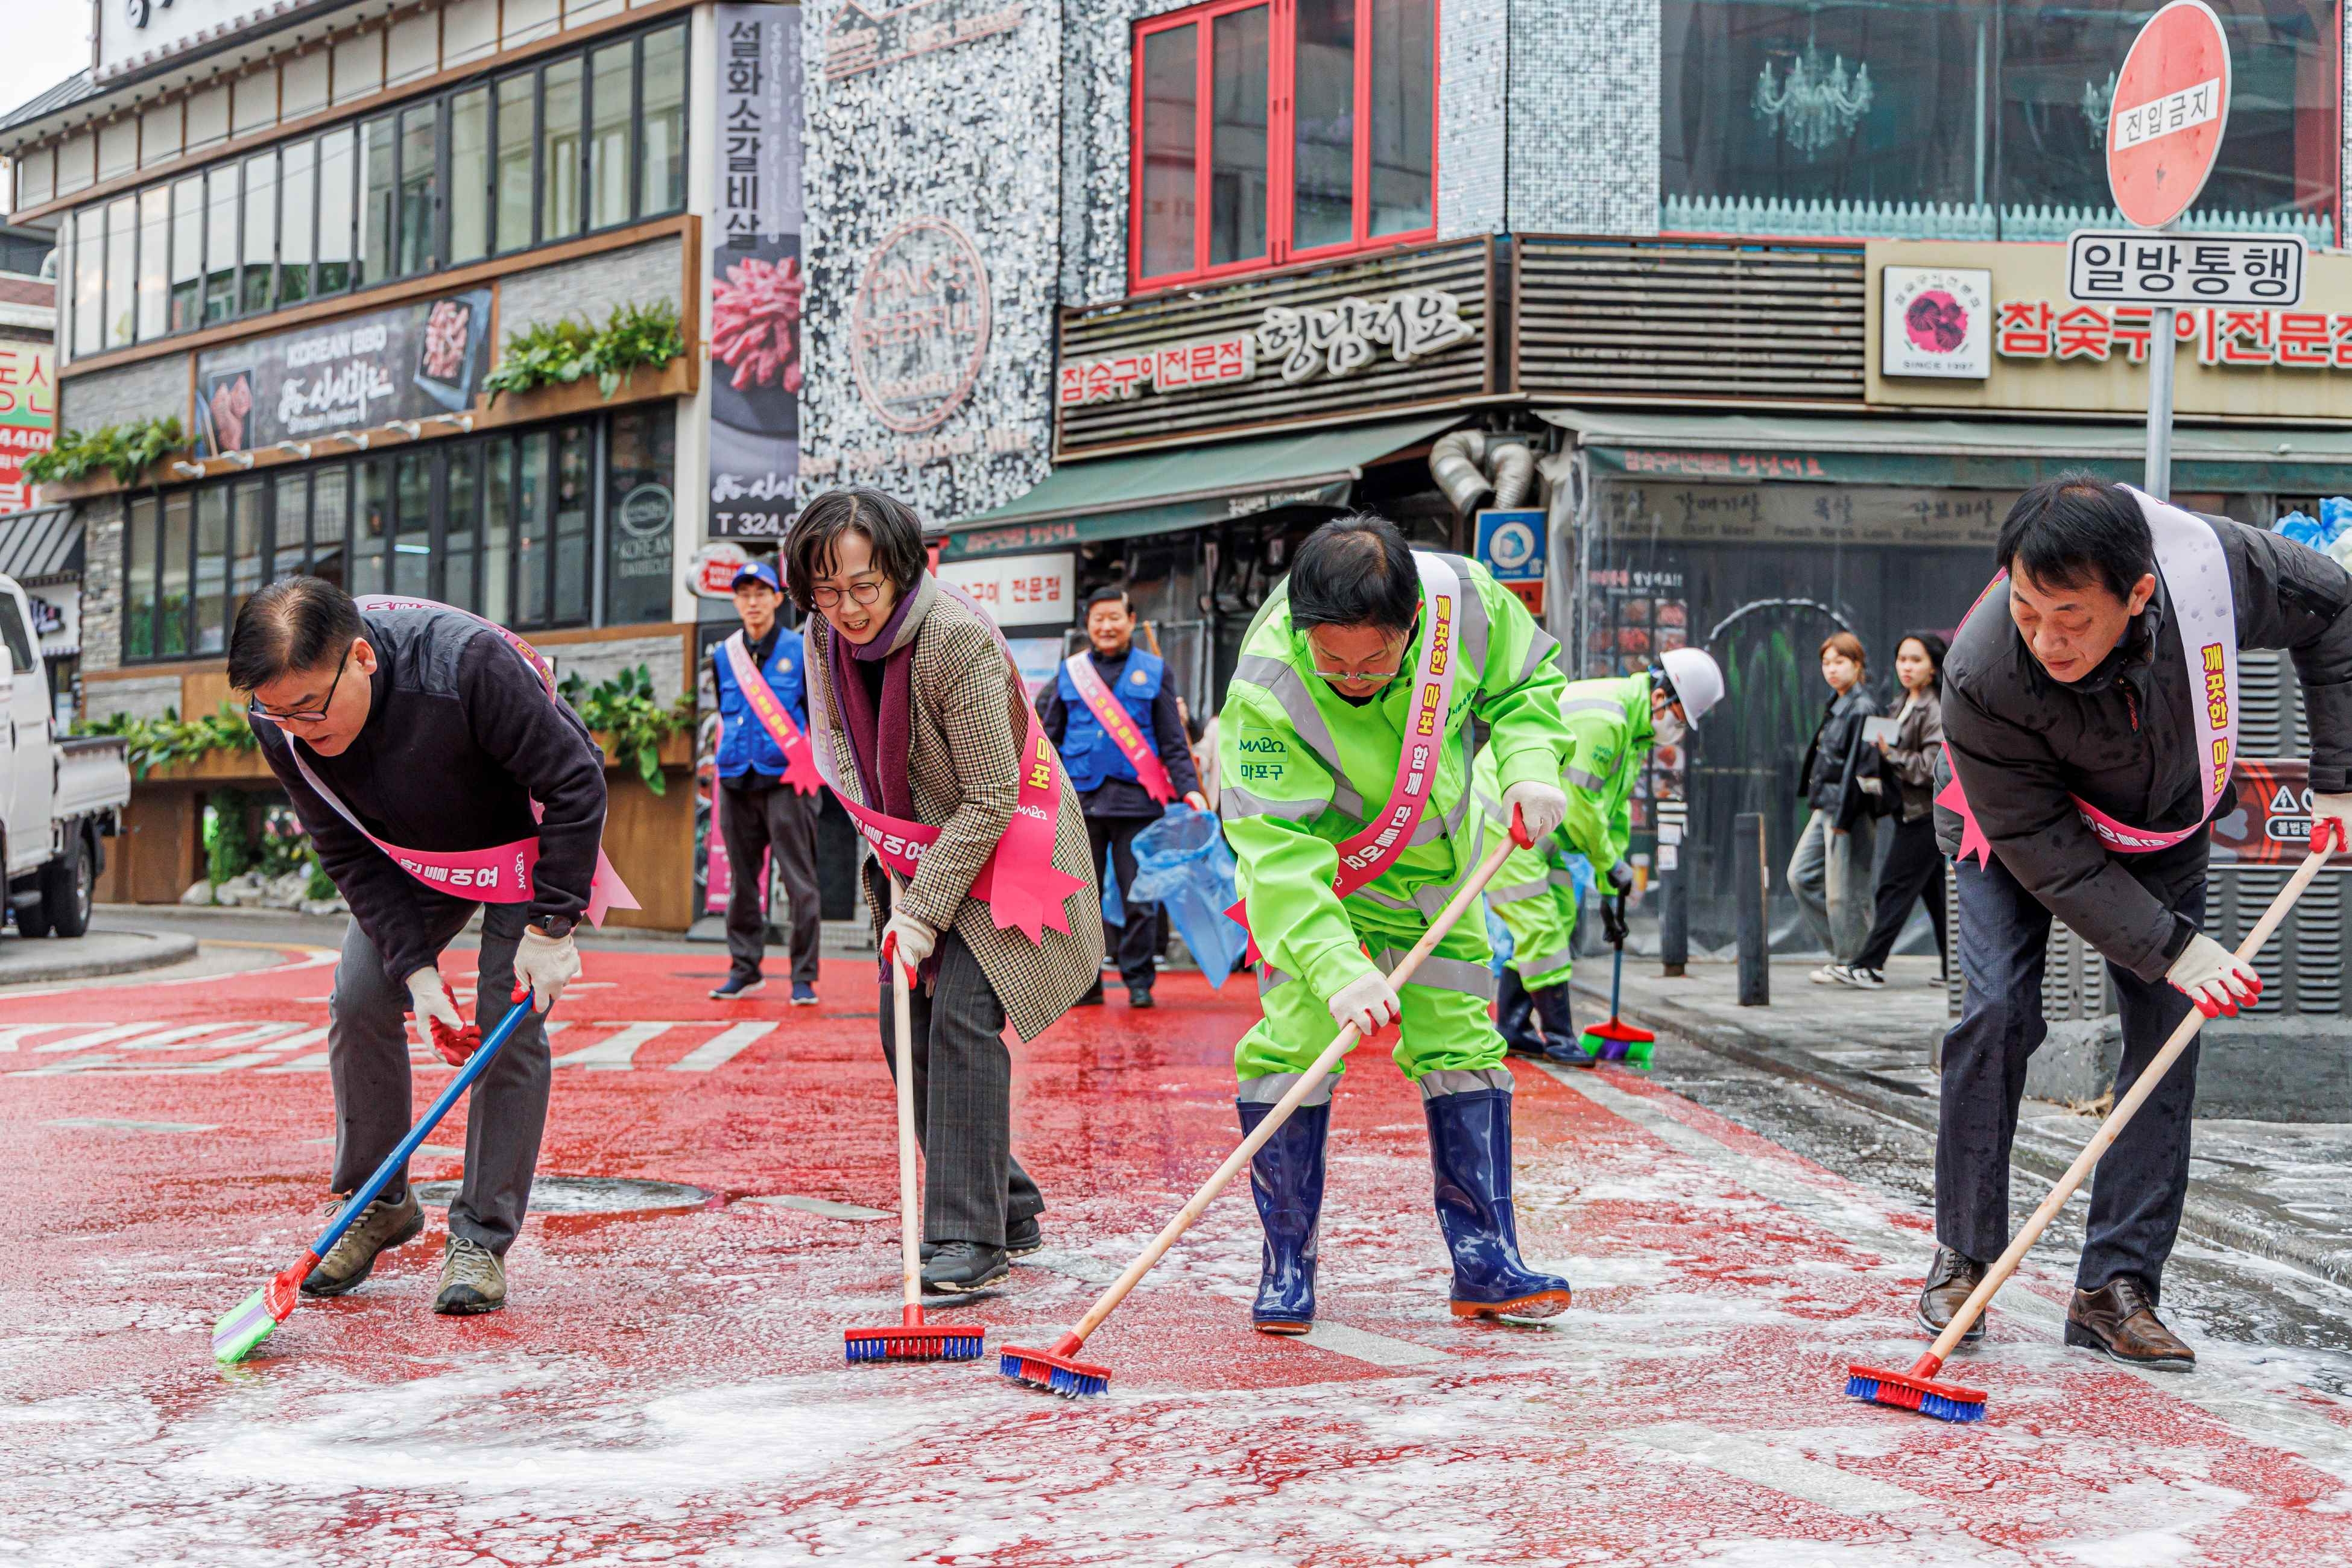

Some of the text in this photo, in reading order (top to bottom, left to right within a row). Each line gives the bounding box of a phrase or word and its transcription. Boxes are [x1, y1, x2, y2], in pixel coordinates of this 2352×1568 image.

[727, 21, 762, 250] 설화소갈비살
[2126, 86, 2208, 143] 진입금지
[2084, 241, 2289, 297] 일방통행
[1061, 338, 1244, 403] 참숯구이전문점
[716, 513, 734, 534] T
[1013, 575, 1060, 604] 전문점
[1341, 593, 1452, 870] 깨끗한 마포 함께 만들어요
[2201, 643, 2228, 795] 깨끗한 마포
[1028, 736, 1051, 789] 마포
[1241, 764, 1284, 780] 마포구
